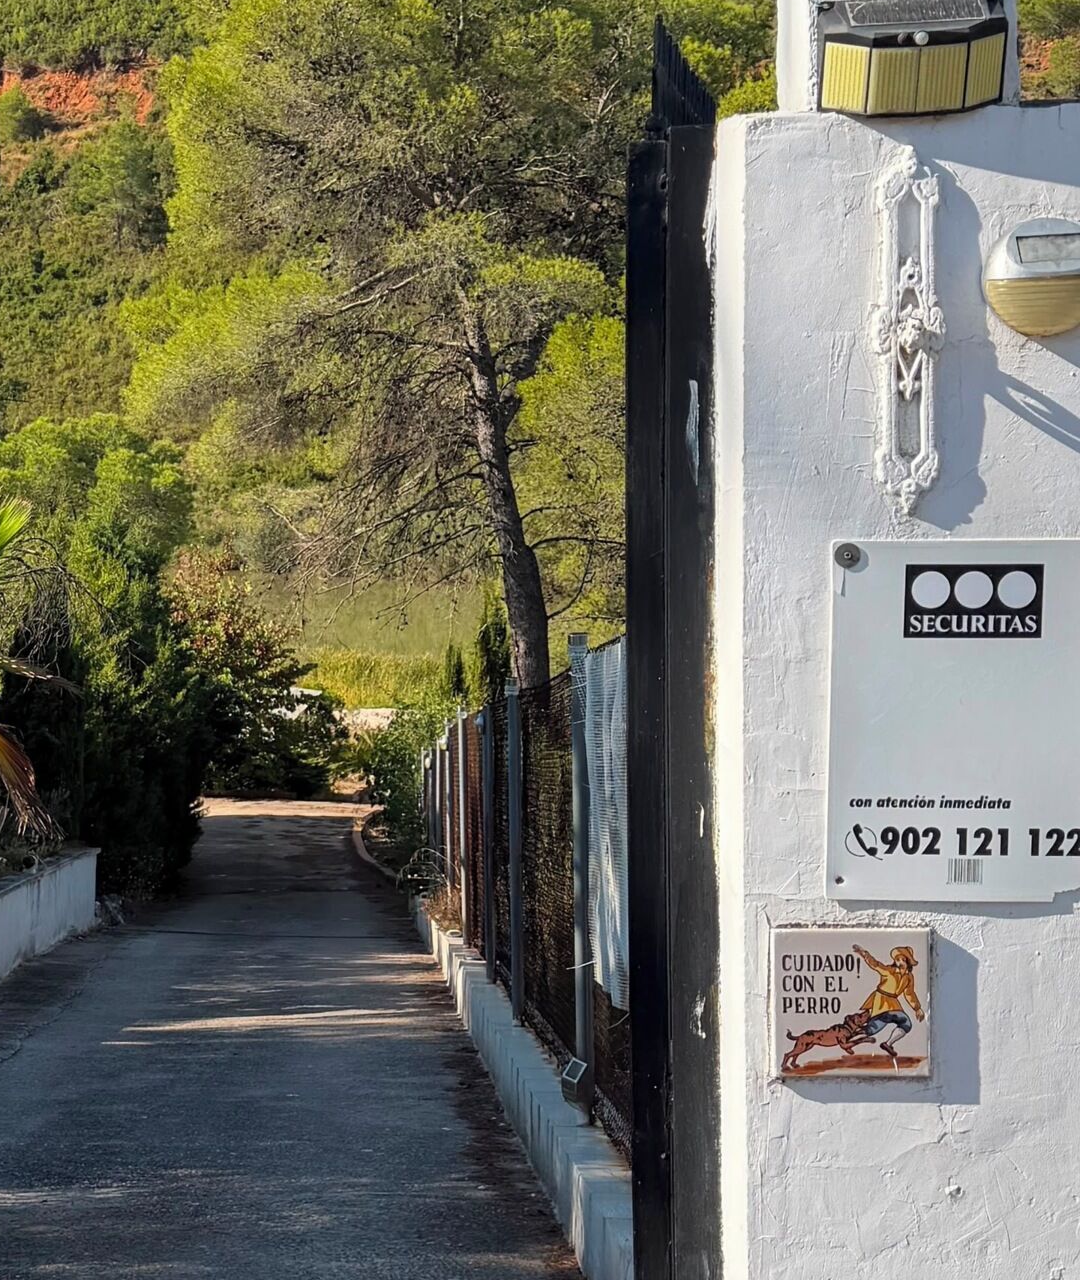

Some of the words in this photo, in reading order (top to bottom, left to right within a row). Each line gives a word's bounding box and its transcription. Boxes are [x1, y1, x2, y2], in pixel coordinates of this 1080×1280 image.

[909, 614, 1038, 634] SECURITAS
[849, 797, 872, 809] con
[876, 795, 936, 809] atención
[939, 795, 1012, 809] inmediata
[880, 826, 942, 856] 902
[956, 827, 1010, 856] 121
[1028, 827, 1080, 857] 122
[781, 953, 861, 979] CUIDADO!
[782, 975, 815, 993] CON
[825, 976, 849, 993] EL
[782, 996, 842, 1015] PERRO
